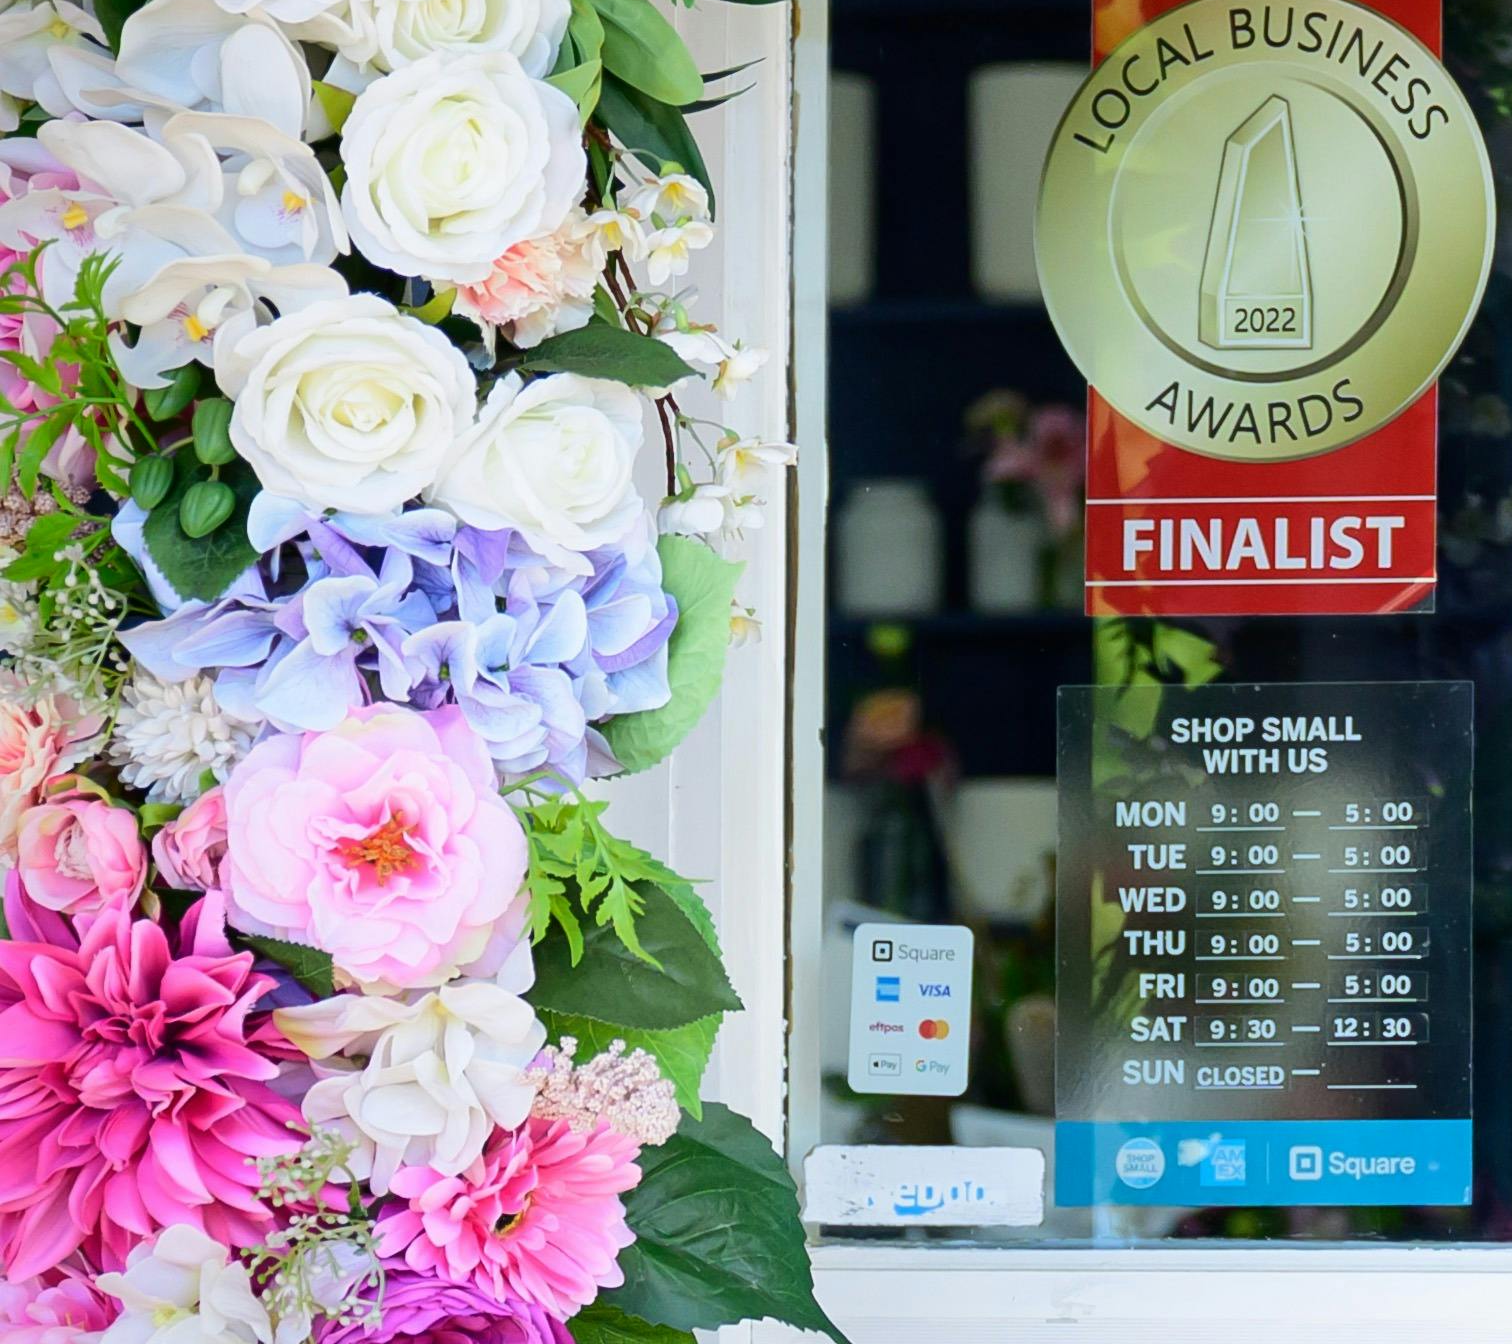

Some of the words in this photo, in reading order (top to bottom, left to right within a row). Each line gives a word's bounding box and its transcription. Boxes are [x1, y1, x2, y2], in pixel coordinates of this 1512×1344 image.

[1073, 22, 1216, 156] LOCAL
[1229, 6, 1450, 141] BUSINESS
[1234, 307, 1297, 334] 2022
[1144, 378, 1366, 445] AWARDS
[1122, 514, 1406, 572] FINALIST
[1170, 717, 1255, 744] SHOP
[1262, 716, 1362, 743] SMALL
[1202, 748, 1280, 774] WITH
[1288, 747, 1328, 774] US
[1115, 801, 1187, 828] MON
[1127, 844, 1187, 871] TUE
[1118, 887, 1187, 914] WED
[897, 944, 956, 964] Square
[1123, 929, 1187, 957] THU
[918, 983, 951, 998] VISA
[1138, 972, 1187, 999] FRI
[868, 1021, 905, 1035] eftpos
[1130, 1016, 1187, 1043] SAT
[880, 1060, 898, 1071] Pay
[929, 1060, 951, 1076] Pay
[1122, 1059, 1186, 1087] SUN
[1196, 1065, 1285, 1088] CLOSED
[1328, 1151, 1417, 1181] Square
